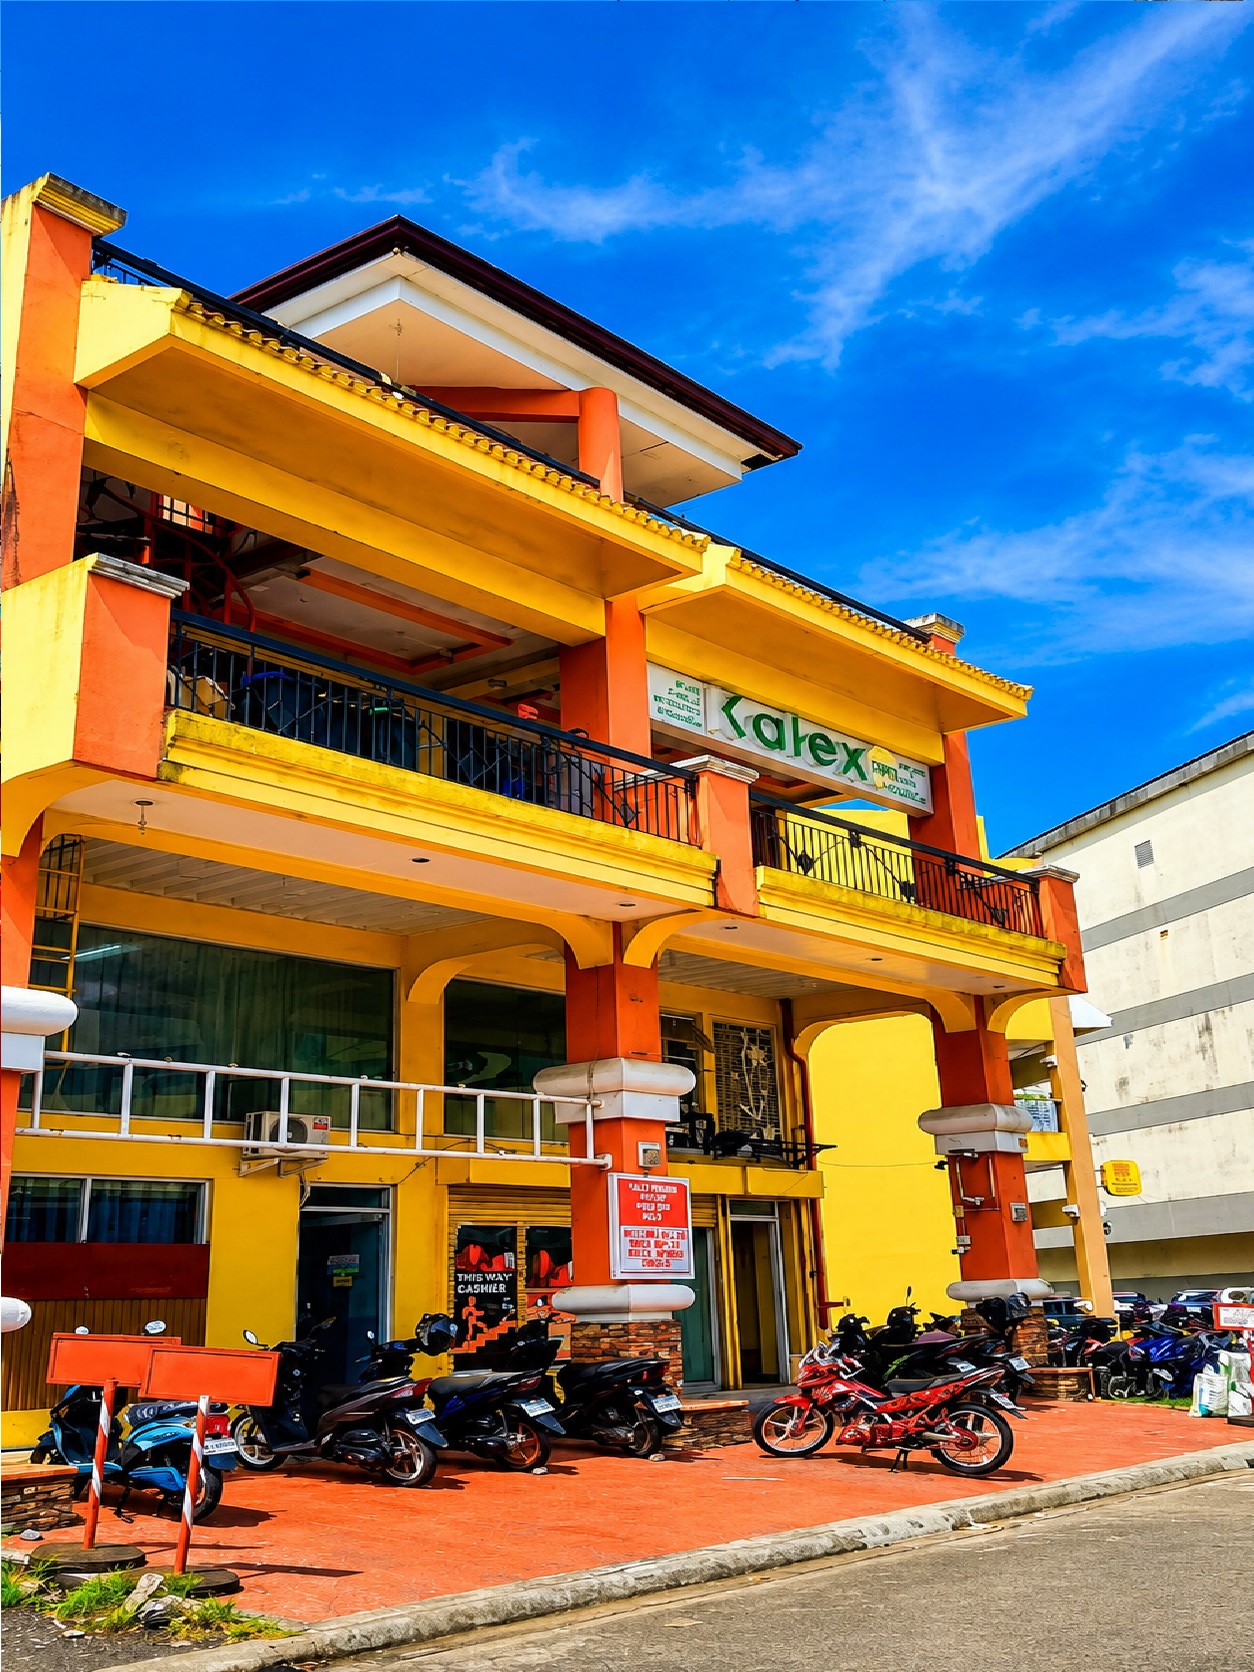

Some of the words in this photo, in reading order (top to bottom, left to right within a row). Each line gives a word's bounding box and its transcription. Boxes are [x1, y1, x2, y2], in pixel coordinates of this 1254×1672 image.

[457, 1273, 483, 1282] THIS
[484, 1273, 512, 1281] WAY
[457, 1283, 507, 1293] CASHIER
